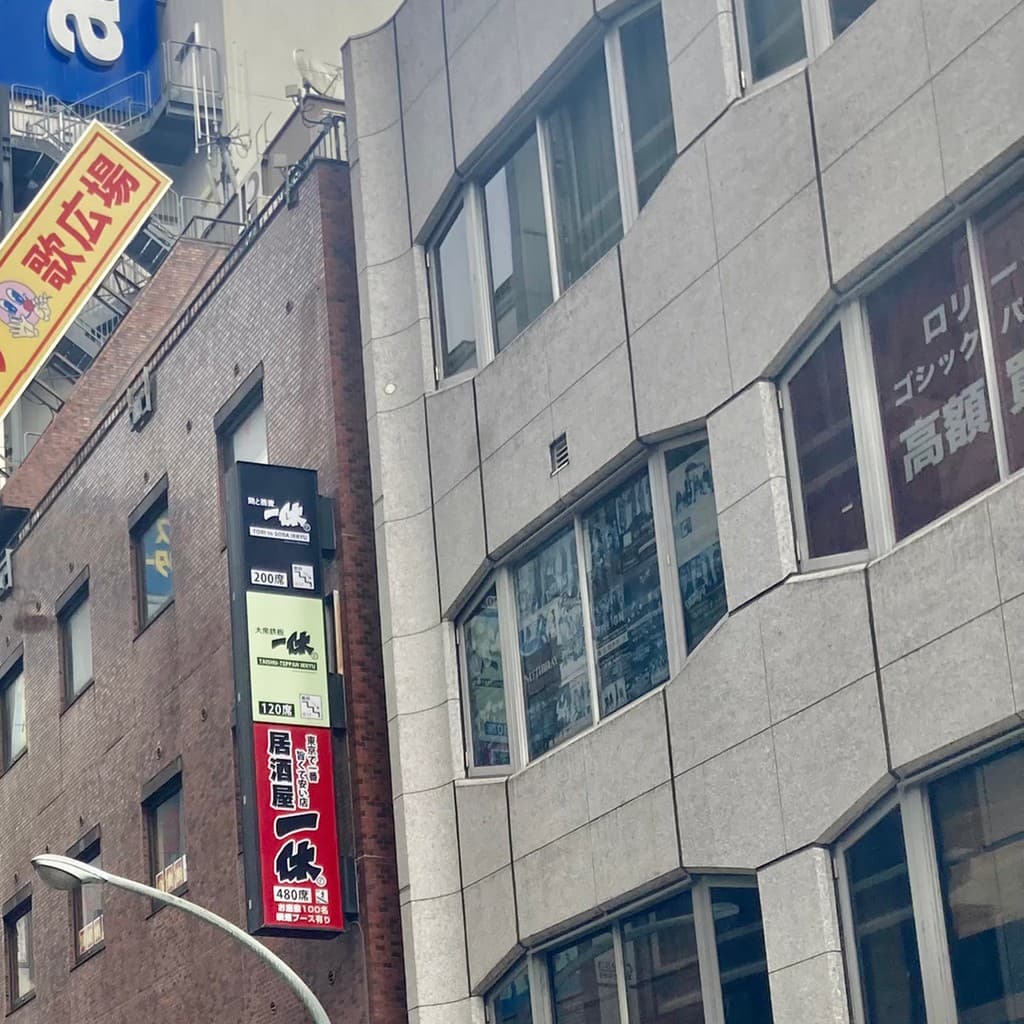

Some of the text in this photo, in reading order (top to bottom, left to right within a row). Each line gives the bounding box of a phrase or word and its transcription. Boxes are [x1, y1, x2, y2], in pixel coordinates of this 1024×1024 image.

[21, 154, 141, 291] 歌広場
[894, 329, 980, 407] ゴシック
[264, 502, 307, 527] 一休
[254, 572, 285, 586] 200席
[271, 631, 314, 655] 一休
[261, 703, 293, 716] 120席
[268, 729, 296, 810] 居酒屋
[295, 749, 310, 809] 旨くて安い店
[305, 733, 320, 784] 東京で一番
[274, 811, 323, 884] 一休
[276, 888, 309, 901] 480席
